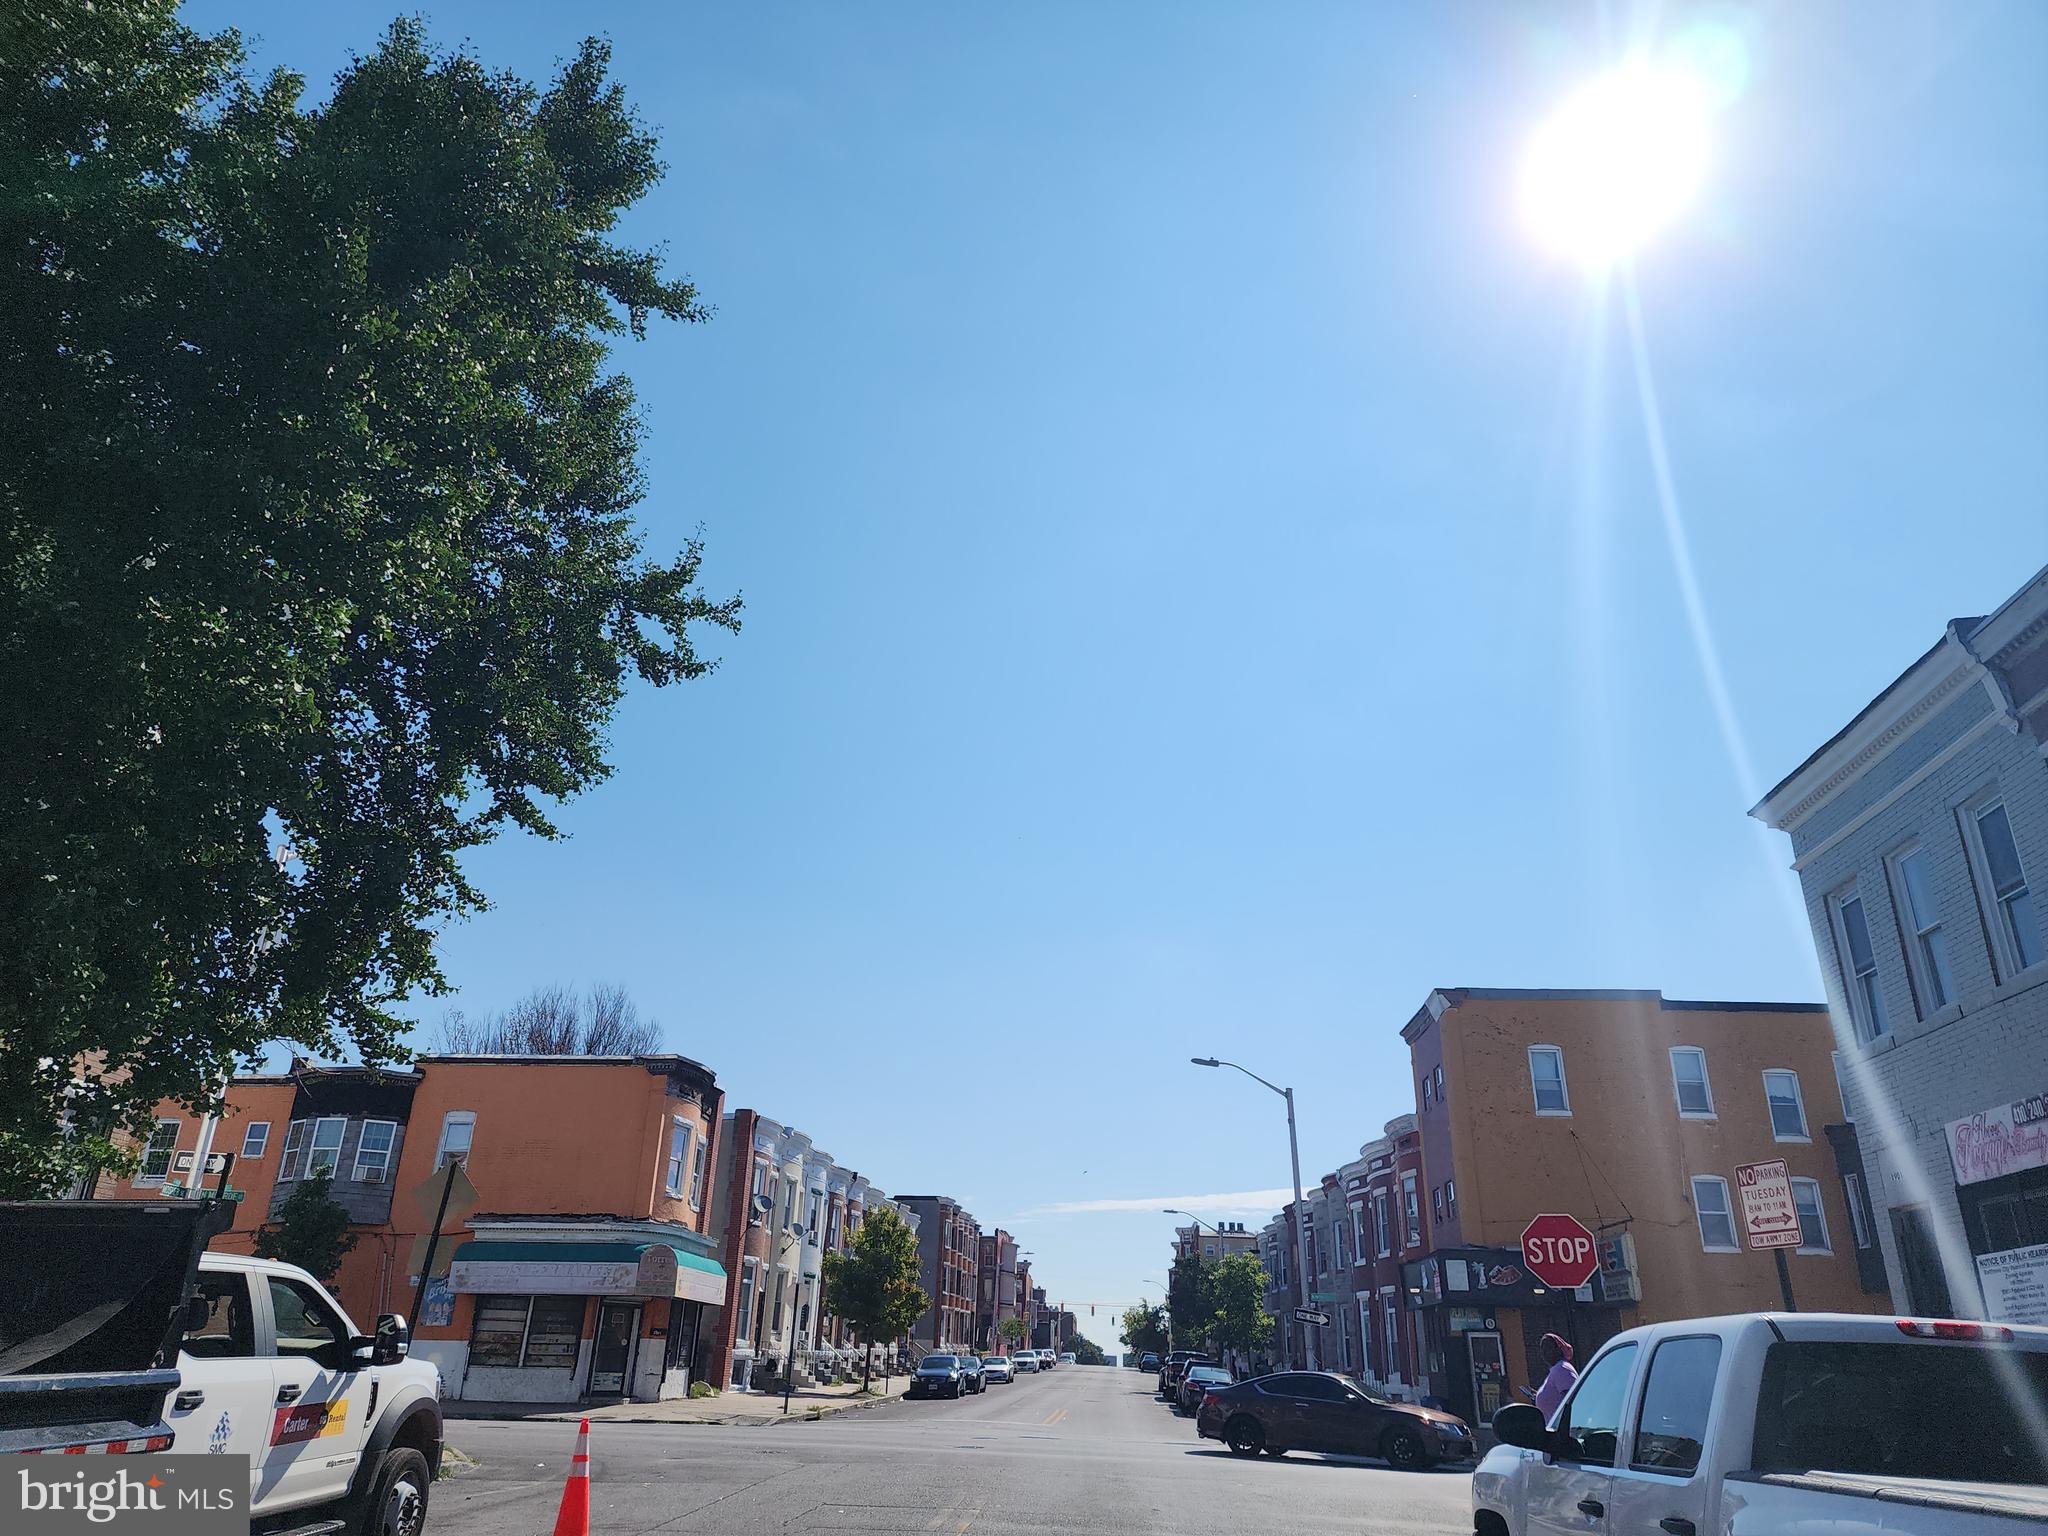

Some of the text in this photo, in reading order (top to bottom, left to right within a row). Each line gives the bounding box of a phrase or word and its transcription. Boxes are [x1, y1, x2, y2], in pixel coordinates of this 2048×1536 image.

[1737, 1165, 1785, 1186] NO PARKING
[1744, 1185, 1787, 1201] TUESDAY
[1762, 1202, 1772, 1212] TO
[1751, 1231, 1799, 1246] TOW AWAY ZONE
[1528, 1237, 1590, 1264] STOP
[1979, 1256, 2000, 1267] NOTICE
[2000, 1255, 2008, 1264] OF
[283, 1417, 309, 1434] Carter
[208, 1443, 227, 1454] SMC
